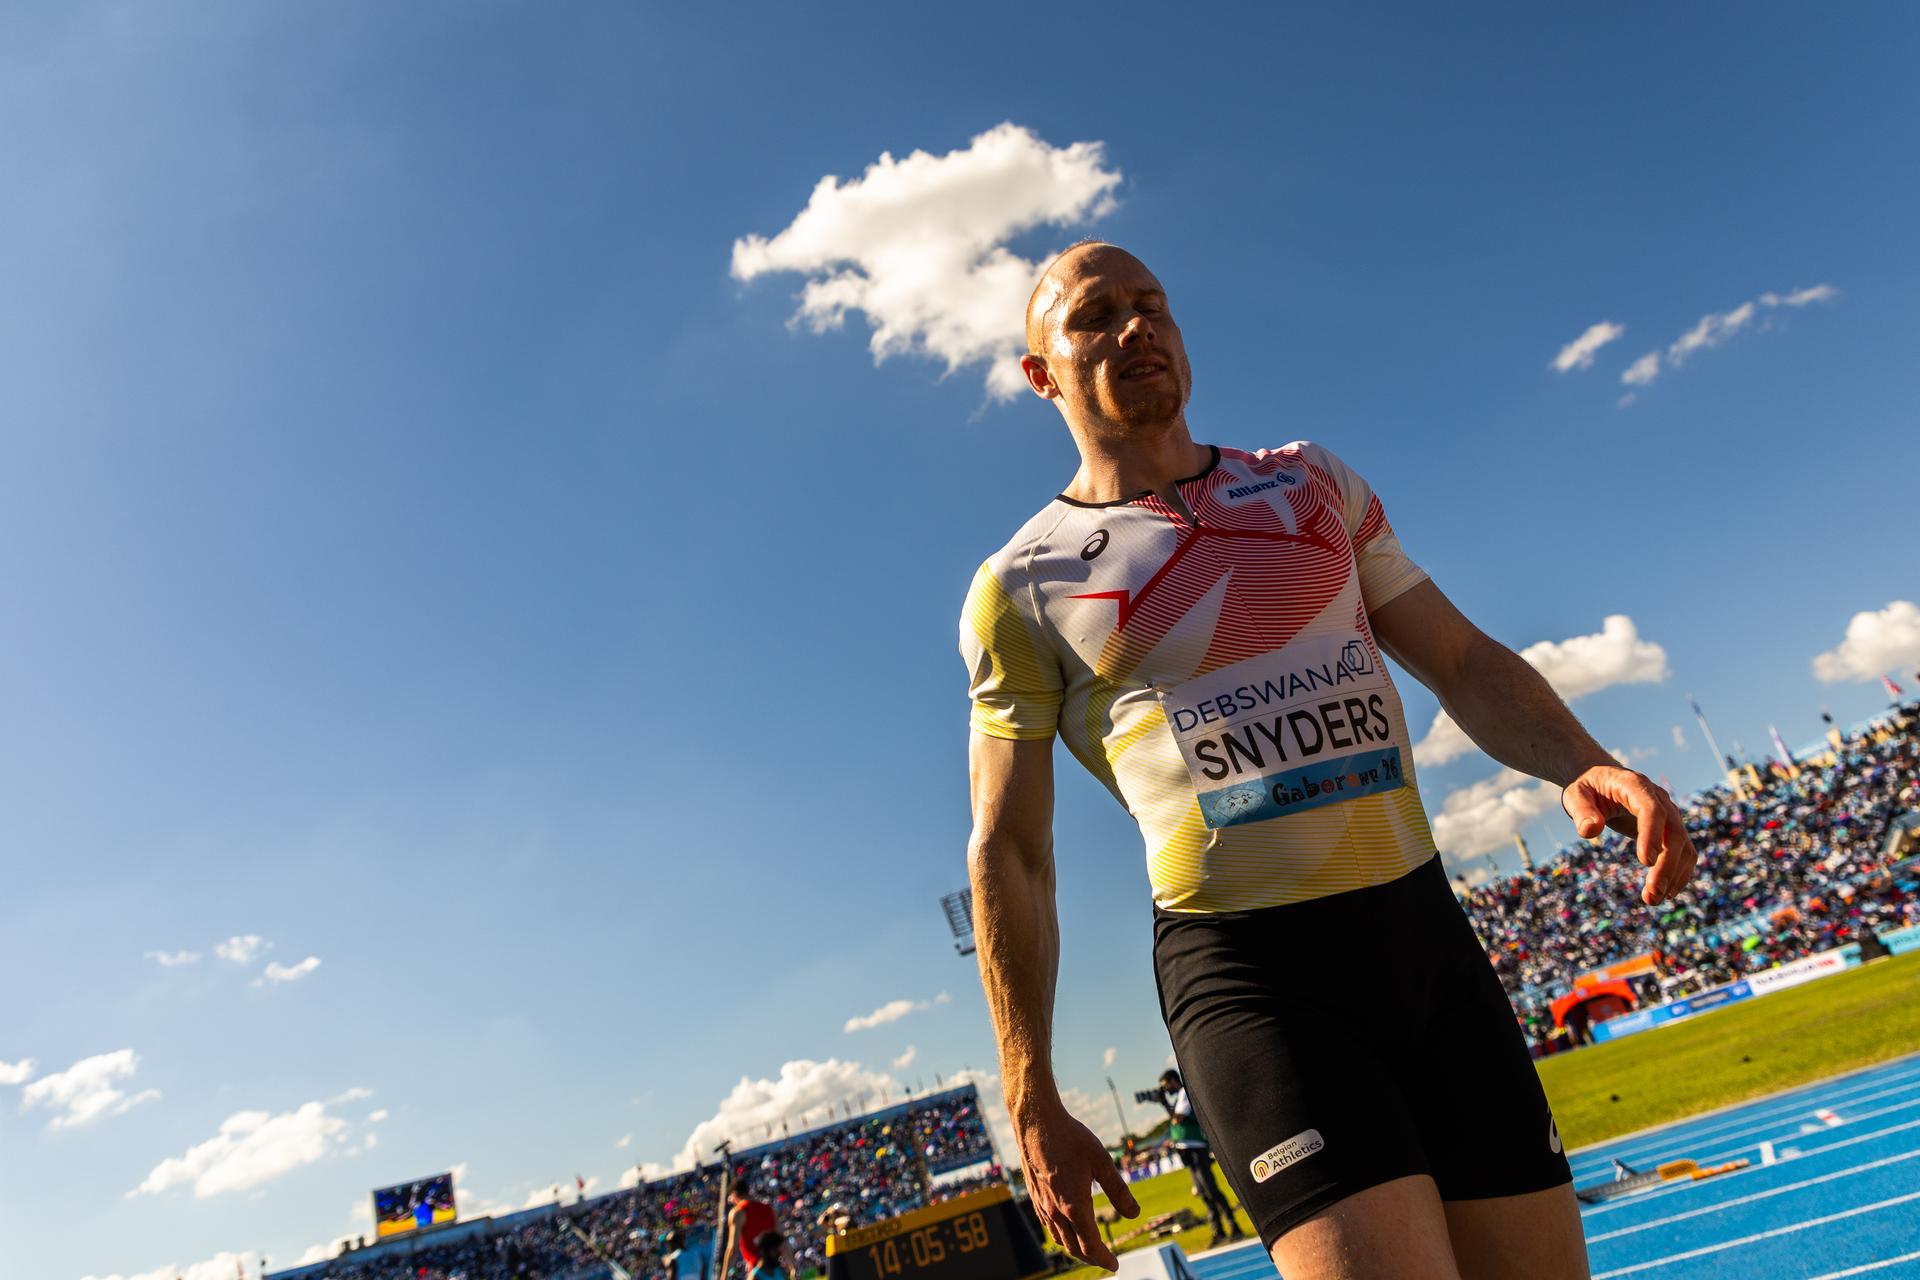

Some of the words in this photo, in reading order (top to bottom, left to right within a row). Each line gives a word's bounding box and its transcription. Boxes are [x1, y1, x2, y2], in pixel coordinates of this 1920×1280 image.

[1227, 481, 1279, 500] Allianz
[1173, 660, 1356, 733] DEBSWANA
[1195, 693, 1390, 781] SNYDERS
[1267, 1141, 1298, 1160] Belgian
[1272, 1140, 1322, 1170] Athletics
[869, 1212, 989, 1280] 14:05:58
